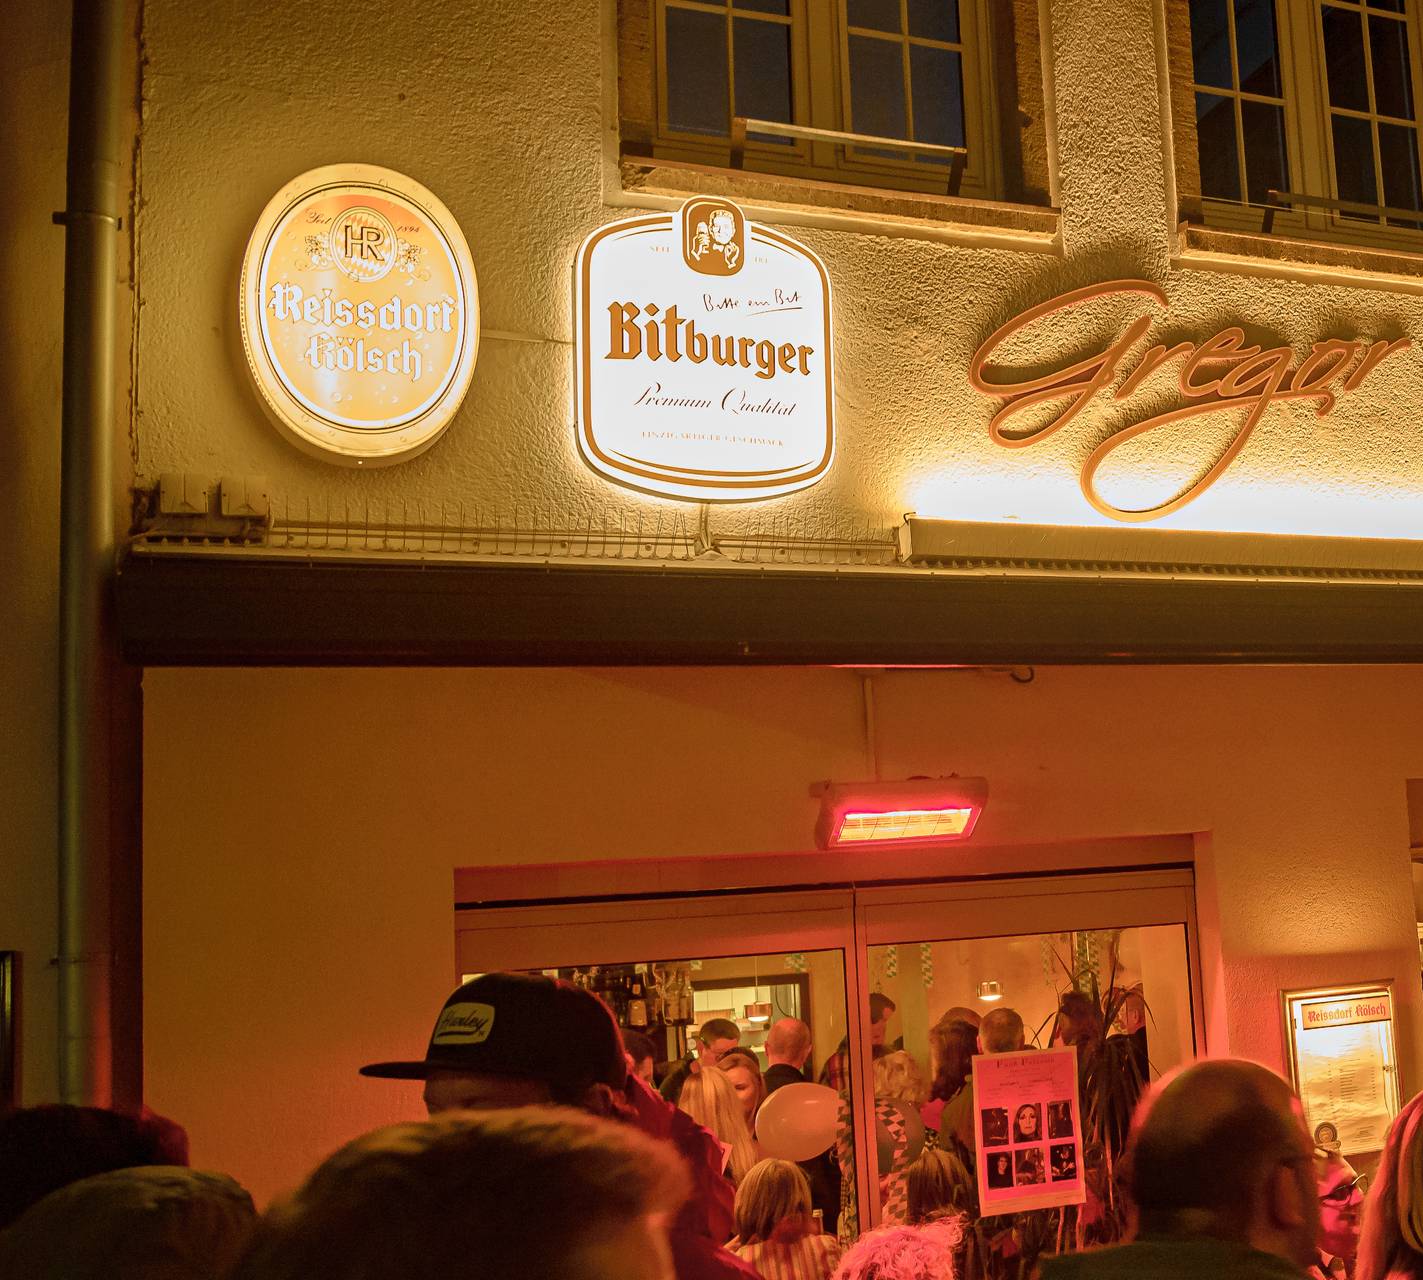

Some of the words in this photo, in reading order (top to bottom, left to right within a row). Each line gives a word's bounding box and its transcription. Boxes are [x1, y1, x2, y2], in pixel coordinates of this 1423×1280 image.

[268, 281, 456, 335] Reissdorf
[304, 332, 422, 383] Kölsch
[604, 301, 815, 380] Bitburger
[634, 382, 713, 409] Premium
[1307, 1006, 1353, 1023] Reissdorf
[1355, 1003, 1387, 1017] Kölsch
